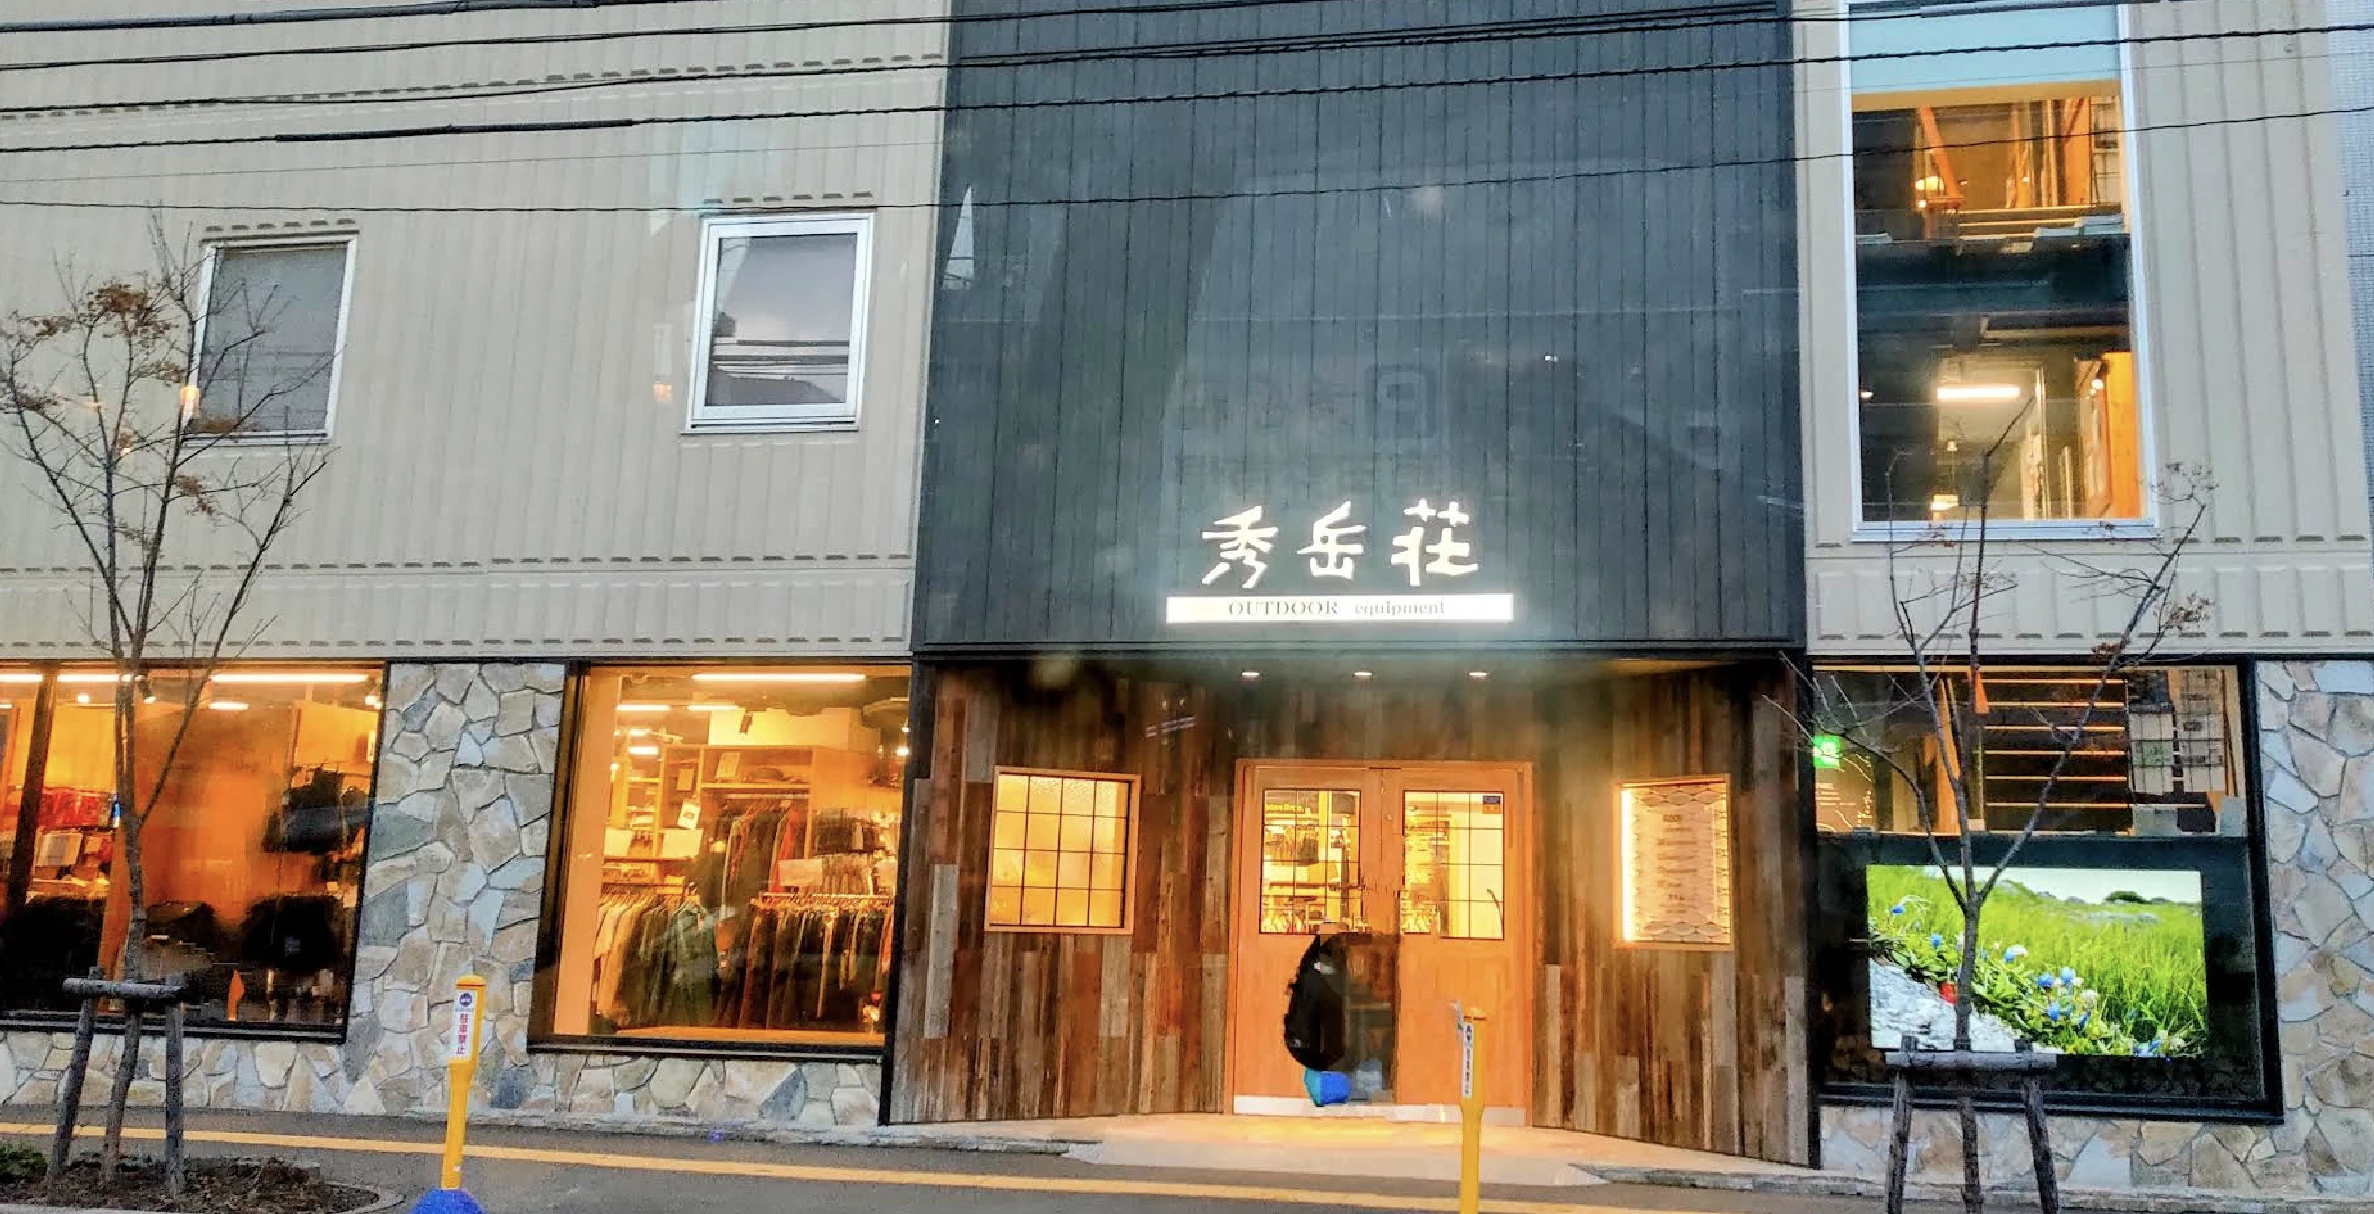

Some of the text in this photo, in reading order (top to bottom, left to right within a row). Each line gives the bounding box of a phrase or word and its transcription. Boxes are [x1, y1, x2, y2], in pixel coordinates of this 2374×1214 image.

[1201, 498, 1479, 588] 秀岳荘
[1228, 600, 1445, 616] OUTDOOR equipment
